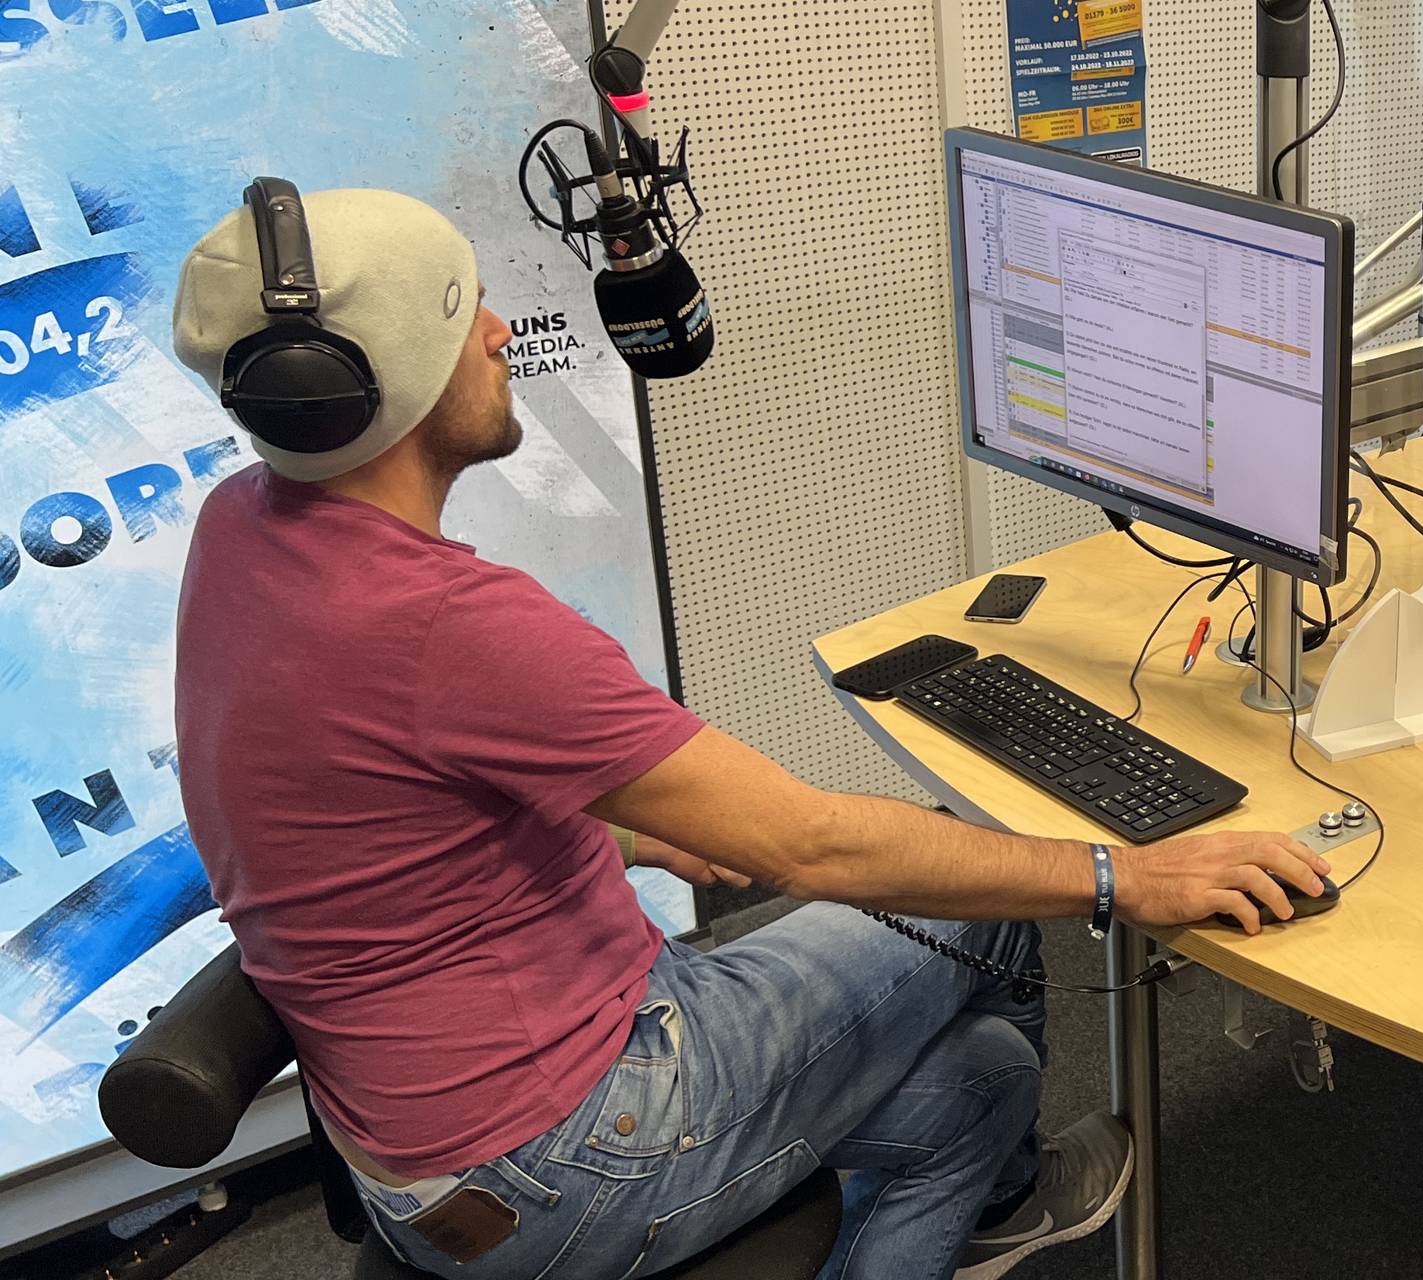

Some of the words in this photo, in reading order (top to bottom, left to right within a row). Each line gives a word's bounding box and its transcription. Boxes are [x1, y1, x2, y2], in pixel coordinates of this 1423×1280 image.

[510, 312, 567, 337] UNS
[506, 335, 586, 360] MEDIA.
[509, 356, 576, 380] REAM.
